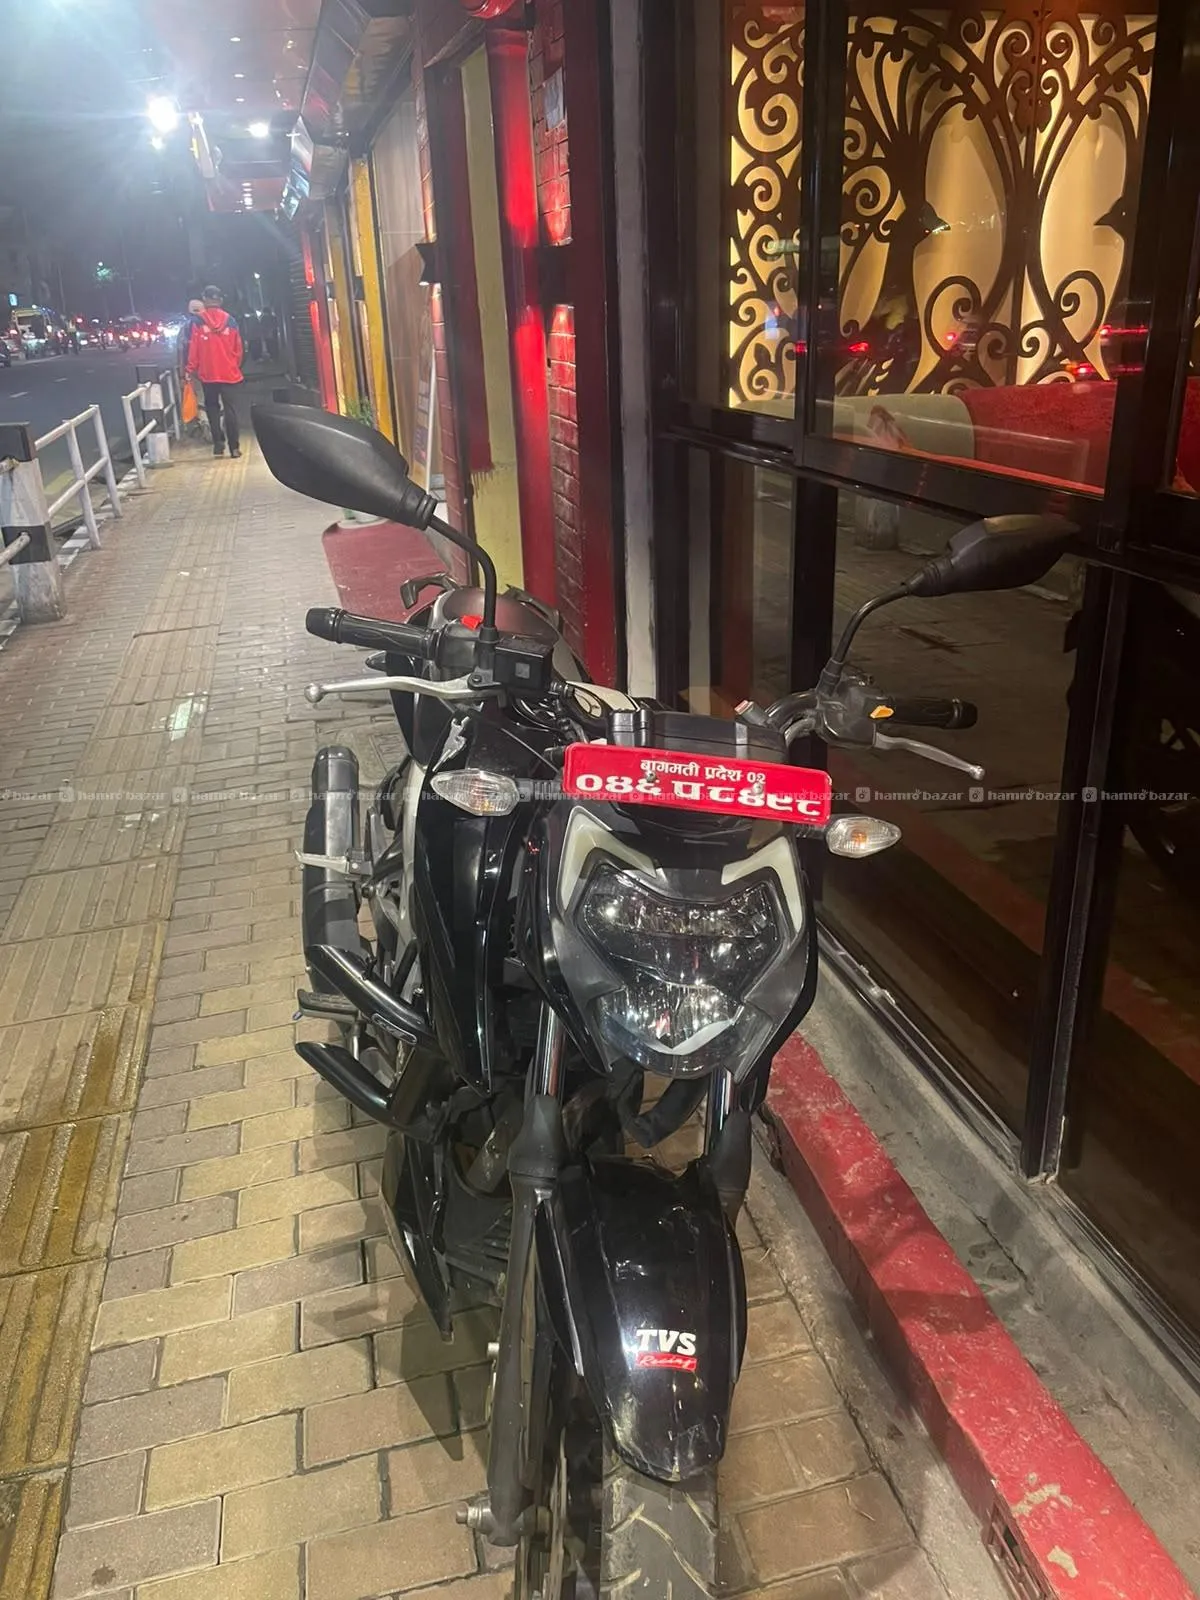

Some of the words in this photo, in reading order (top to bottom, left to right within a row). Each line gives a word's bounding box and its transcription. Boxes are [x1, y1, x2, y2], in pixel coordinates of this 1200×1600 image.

[640, 759, 701, 777] बागमती
[704, 764, 742, 782] प्रदेश
[636, 1329, 697, 1356] TVS
